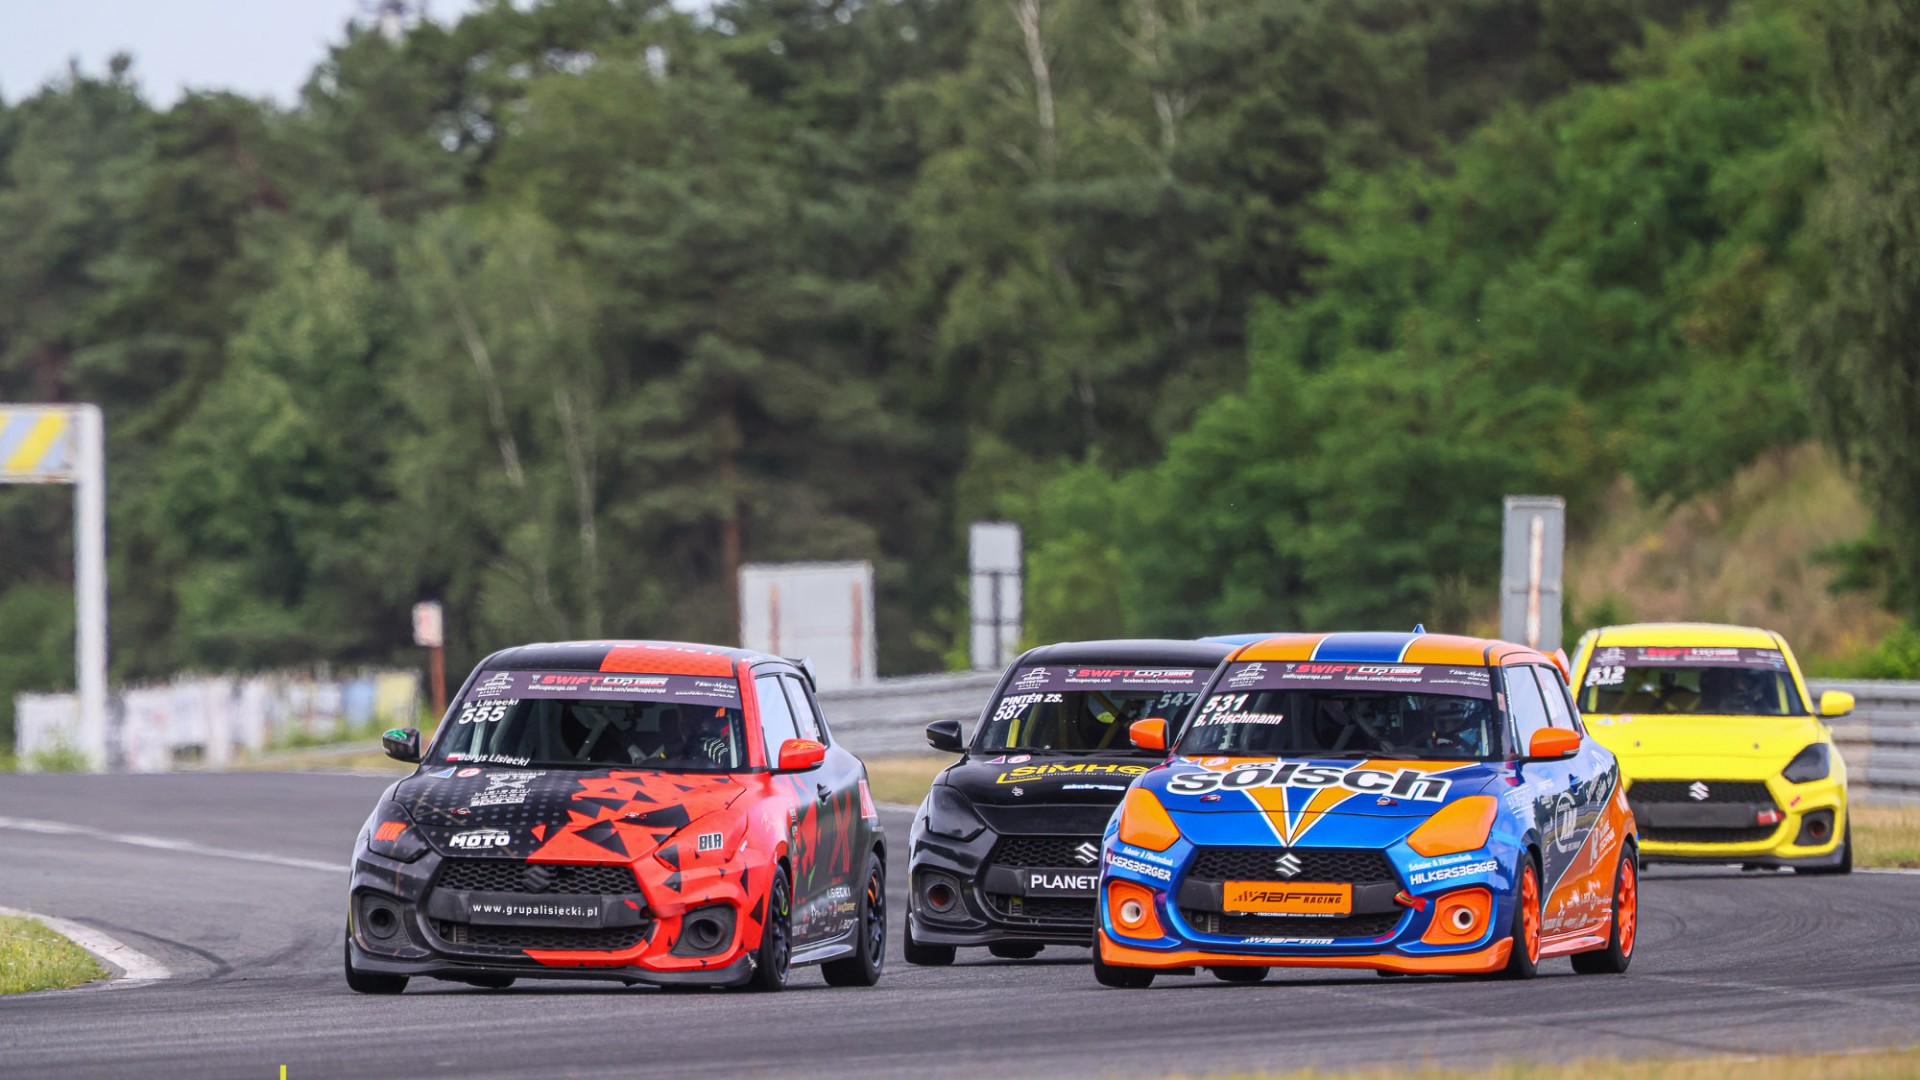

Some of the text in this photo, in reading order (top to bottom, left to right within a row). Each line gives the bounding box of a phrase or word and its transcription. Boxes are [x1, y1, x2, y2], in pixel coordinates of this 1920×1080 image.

[1077, 669, 1136, 677] SWIFT
[1134, 670, 1163, 678] CUP
[1295, 665, 1359, 674] SWIFT
[1357, 666, 1389, 675] CUP
[541, 675, 604, 685] SWIFT
[603, 677, 632, 686] CUP
[477, 699, 519, 707] Lisiecki
[1001, 693, 1063, 706] PINTÉR ZS.
[1157, 692, 1200, 708] 547
[1202, 693, 1249, 713] 531
[458, 706, 506, 724] 555
[993, 704, 1028, 722] 587
[1193, 711, 1284, 728] B. Frischmann
[458, 753, 530, 766] Borys Lisiecki
[1166, 761, 1452, 802] sölsch
[449, 834, 510, 847] MOTO
[1409, 860, 1498, 885] HILKERSBERGER
[1031, 874, 1099, 889] PLANET
[1250, 892, 1342, 904] ABF RACING
[472, 903, 598, 917] www.grupalisiecki.pl
